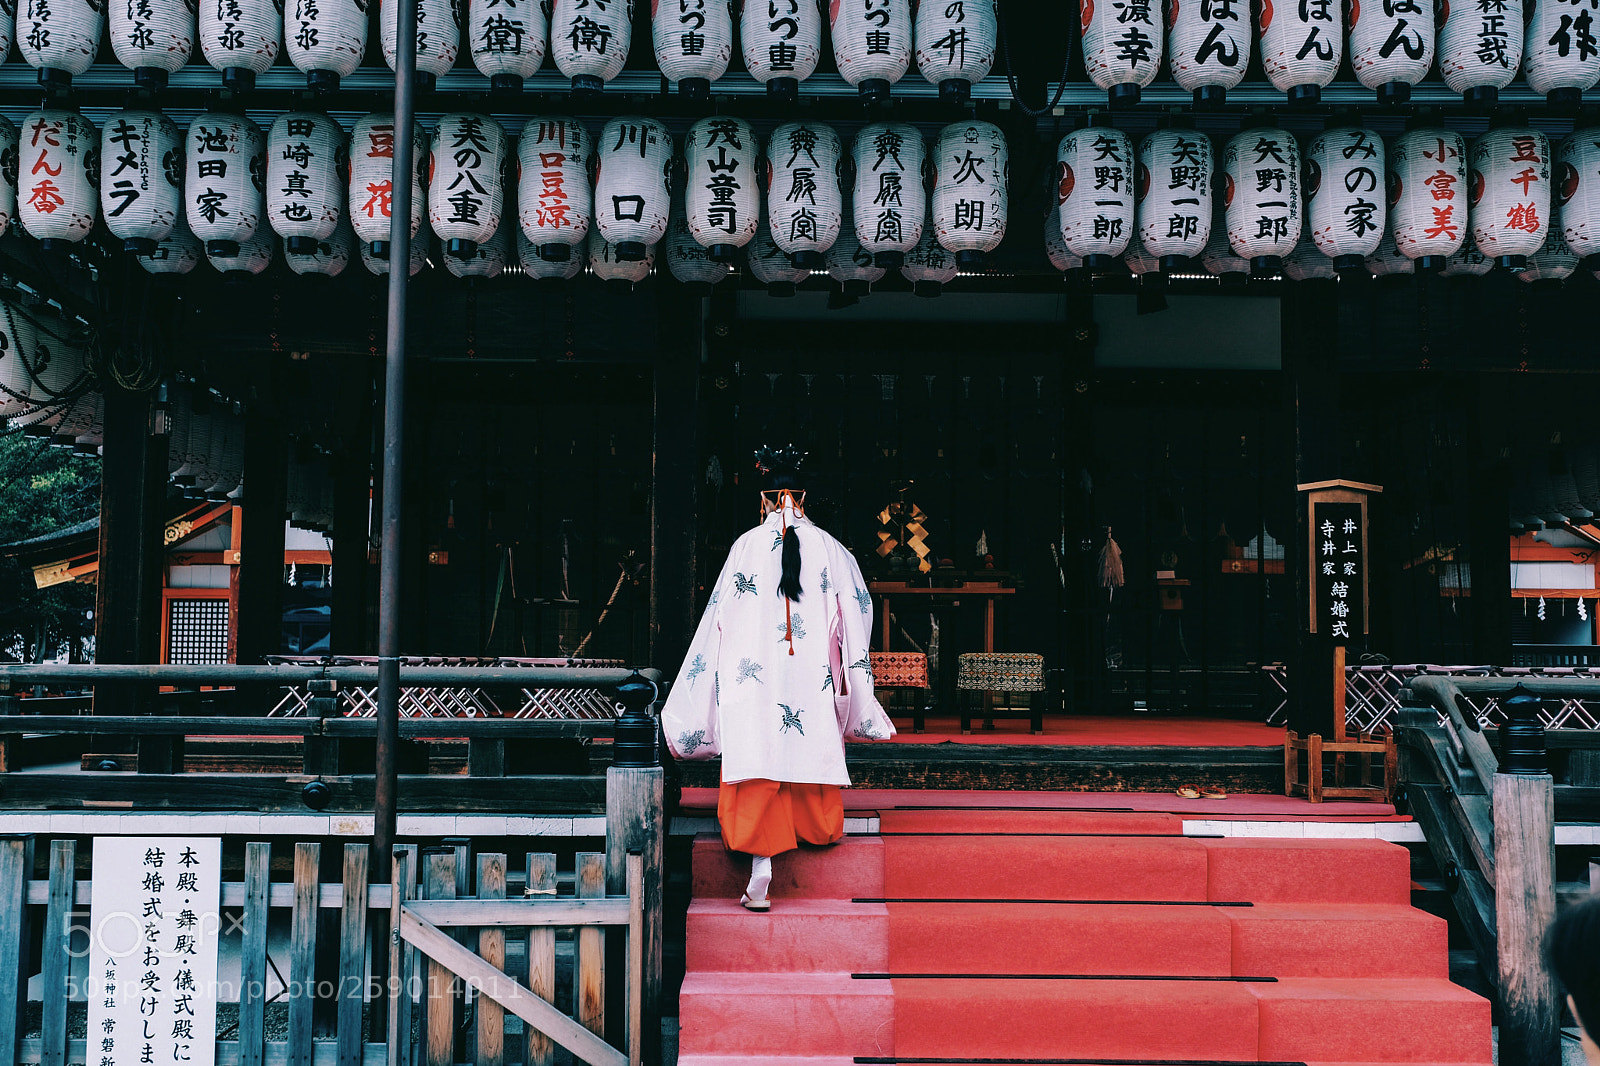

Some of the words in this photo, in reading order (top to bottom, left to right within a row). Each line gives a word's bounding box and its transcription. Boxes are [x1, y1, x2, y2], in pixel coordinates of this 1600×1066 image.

[108, 119, 141, 217] キメラ
[140, 118, 152, 190] Ristorante
[195, 126, 229, 223] 池田家
[280, 119, 316, 222] 田崎真也
[446, 117, 493, 226] 美の八重
[612, 124, 648, 223] 川口
[705, 119, 742, 235] 茂山童司
[952, 149, 985, 232] 次朗
[988, 130, 1002, 228] ステーキハウス
[1090, 134, 1124, 244] 矢野一郎
[1166, 137, 1201, 241] 矢野一郎
[1253, 137, 1288, 244] 矢野一郎
[1342, 131, 1378, 238] みの家
[1422, 137, 1458, 241] 小富美
[1504, 135, 1541, 234] 豆千鶴
[1320, 519, 1337, 576] 寺井家
[1341, 518, 1358, 576] 井上家
[1330, 581, 1350, 638] 結婚式
[103, 957, 117, 1008] 八坂神社
[140, 847, 166, 1064] 結婚式をお受けしま
[171, 846, 200, 1061] 本殿・舞殿・儀式殿に
